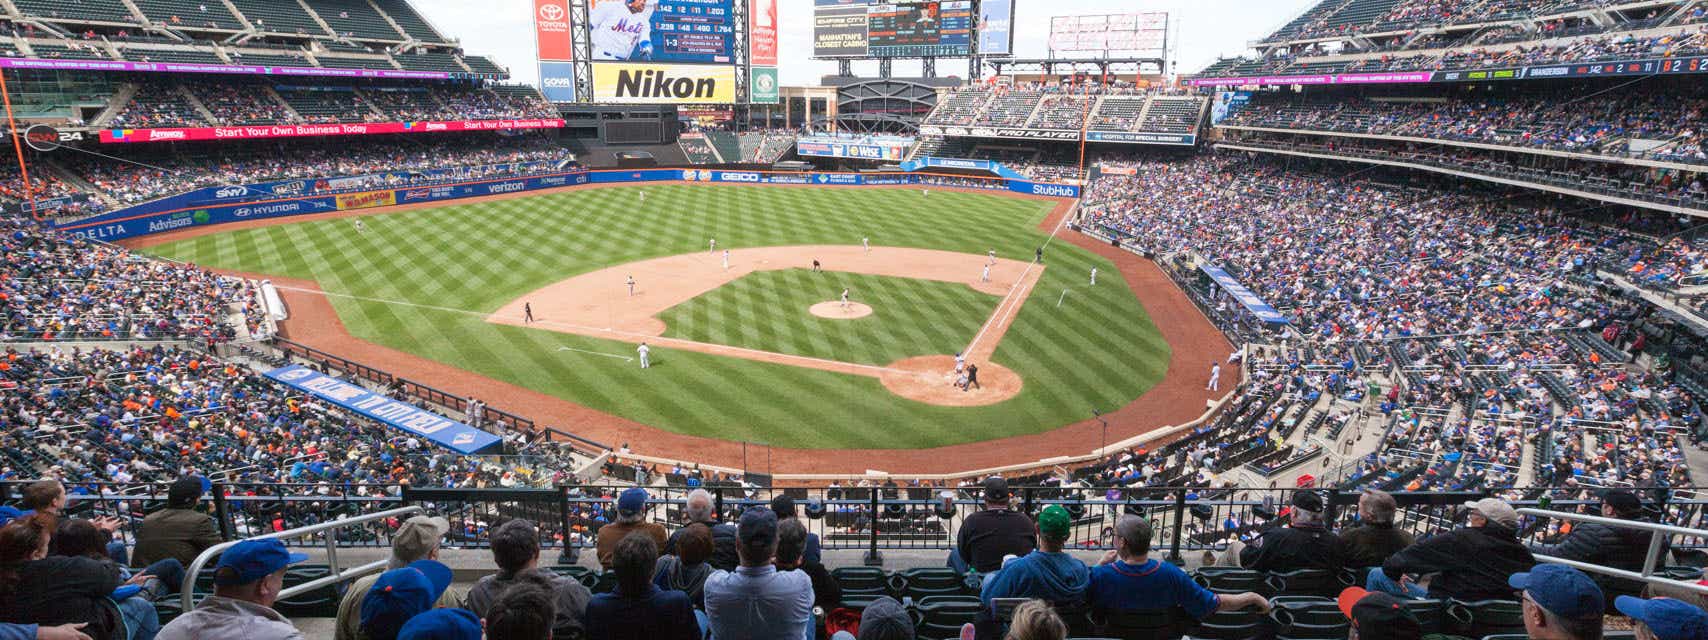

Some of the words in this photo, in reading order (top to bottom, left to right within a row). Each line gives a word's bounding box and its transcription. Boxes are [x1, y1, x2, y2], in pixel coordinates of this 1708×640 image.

[611, 18, 642, 33] Mets
[843, 40, 867, 48] CASINO
[1616, 64, 1624, 73] 2
[1645, 62, 1653, 72] 11
[1672, 60, 1681, 72] 2
[1699, 58, 1708, 70] 2
[544, 77, 570, 88] GOYA
[615, 70, 716, 98] Nikon
[464, 121, 482, 129] Start
[483, 121, 498, 129] Your
[500, 120, 513, 128] Own
[514, 119, 541, 128] Business
[542, 119, 559, 128] Today
[58, 131, 84, 141] 24
[150, 129, 185, 140] Amway
[215, 128, 244, 137] Start
[246, 127, 269, 137] Your
[271, 127, 294, 136] Own
[296, 125, 341, 135] Business
[342, 124, 367, 135] Today
[997, 129, 1025, 137] PRO
[1026, 131, 1078, 139] PLAYER
[858, 145, 881, 157] WISE
[721, 172, 758, 182] GEICO
[215, 187, 242, 199] SNY
[488, 182, 524, 193] verizon
[1032, 184, 1074, 197] StubHub
[254, 203, 300, 215] HYUNDAI
[149, 217, 192, 231] Advisors
[75, 224, 126, 241] DELTA
